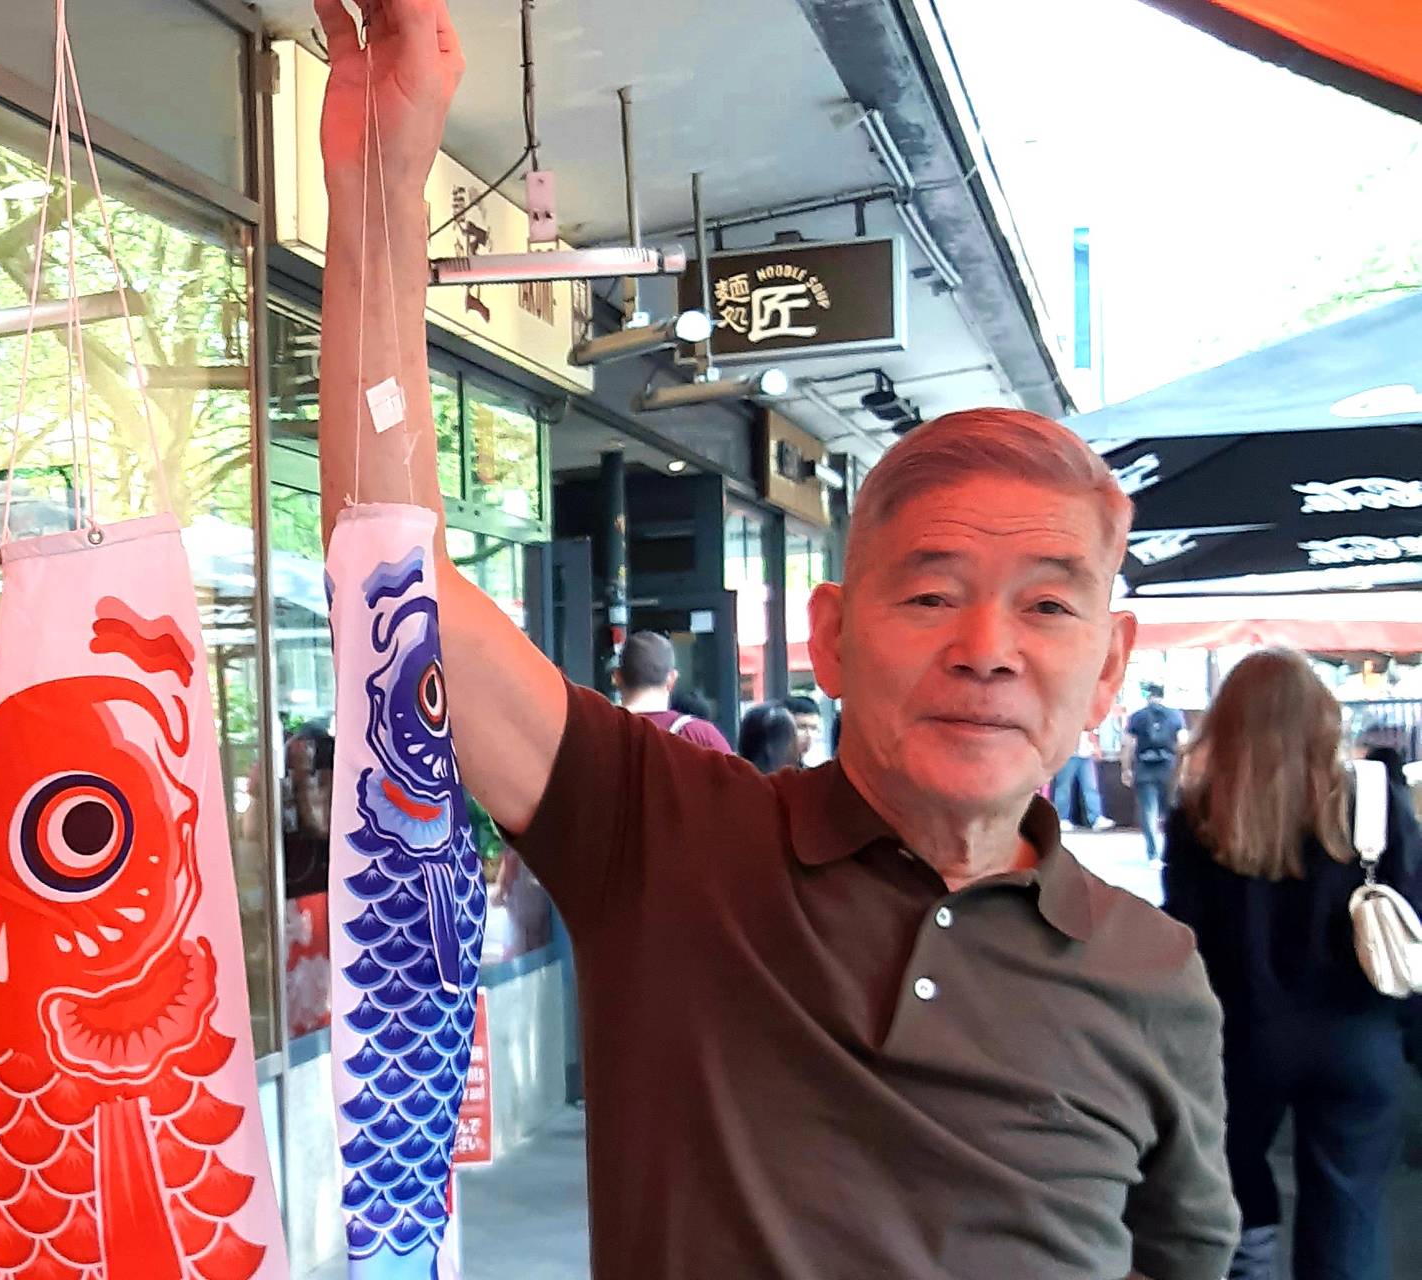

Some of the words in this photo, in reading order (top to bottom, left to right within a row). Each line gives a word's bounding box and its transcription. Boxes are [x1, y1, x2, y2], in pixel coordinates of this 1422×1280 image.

[747, 283, 817, 342] 匠
[755, 264, 807, 282] NOODLE
[805, 276, 831, 309] SOUP
